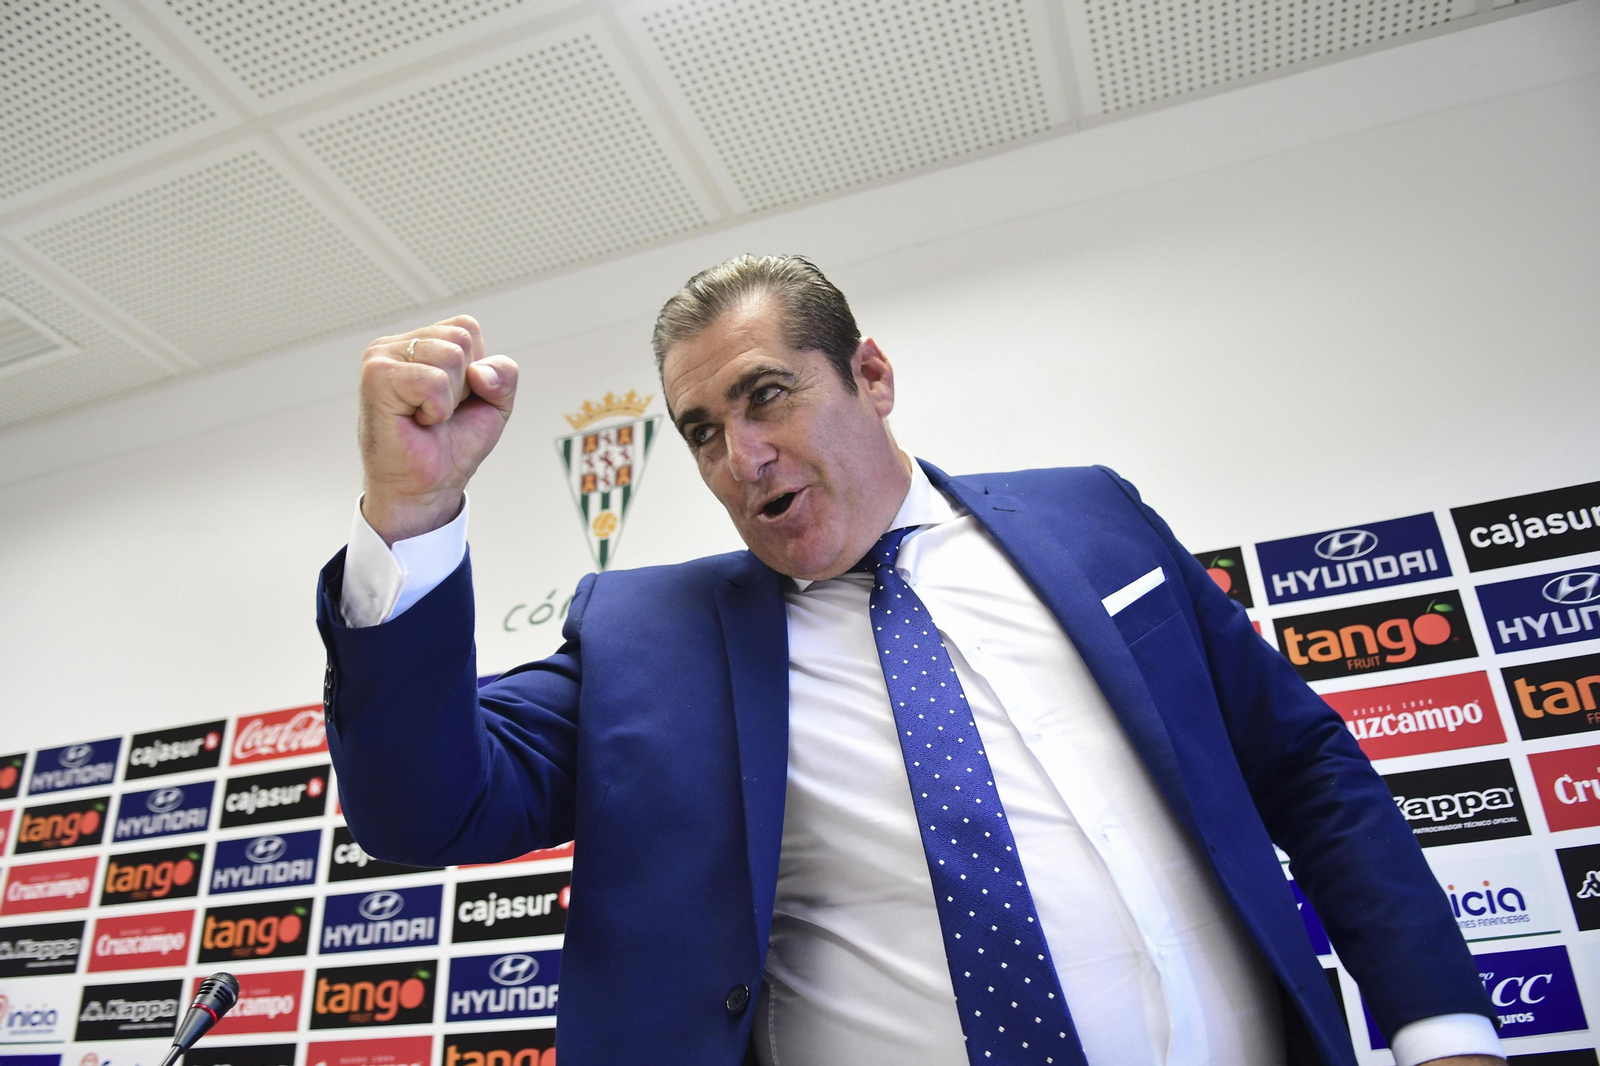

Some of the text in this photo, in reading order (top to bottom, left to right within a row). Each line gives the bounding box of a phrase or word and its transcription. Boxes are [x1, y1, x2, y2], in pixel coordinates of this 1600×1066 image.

[1272, 549, 1438, 597] HYUNDAI
[1283, 613, 1452, 665] tango
[1496, 604, 1600, 644] HYUN
[1347, 656, 1381, 670] FRUIT
[1514, 675, 1600, 719] tan
[1345, 701, 1483, 740] uzcampo
[130, 737, 205, 768] cajasur
[31, 762, 114, 792] HYUNDAI
[225, 783, 307, 815] cajasur
[18, 810, 100, 846] tango
[115, 808, 207, 838] HYUNDAI
[105, 859, 195, 897] tango
[212, 858, 314, 890] HYUNDAI
[458, 892, 558, 926] cajasur
[1448, 880, 1526, 918] icia
[203, 914, 302, 955] tango
[323, 916, 435, 948] HYUNDAI
[315, 977, 425, 1022] tango
